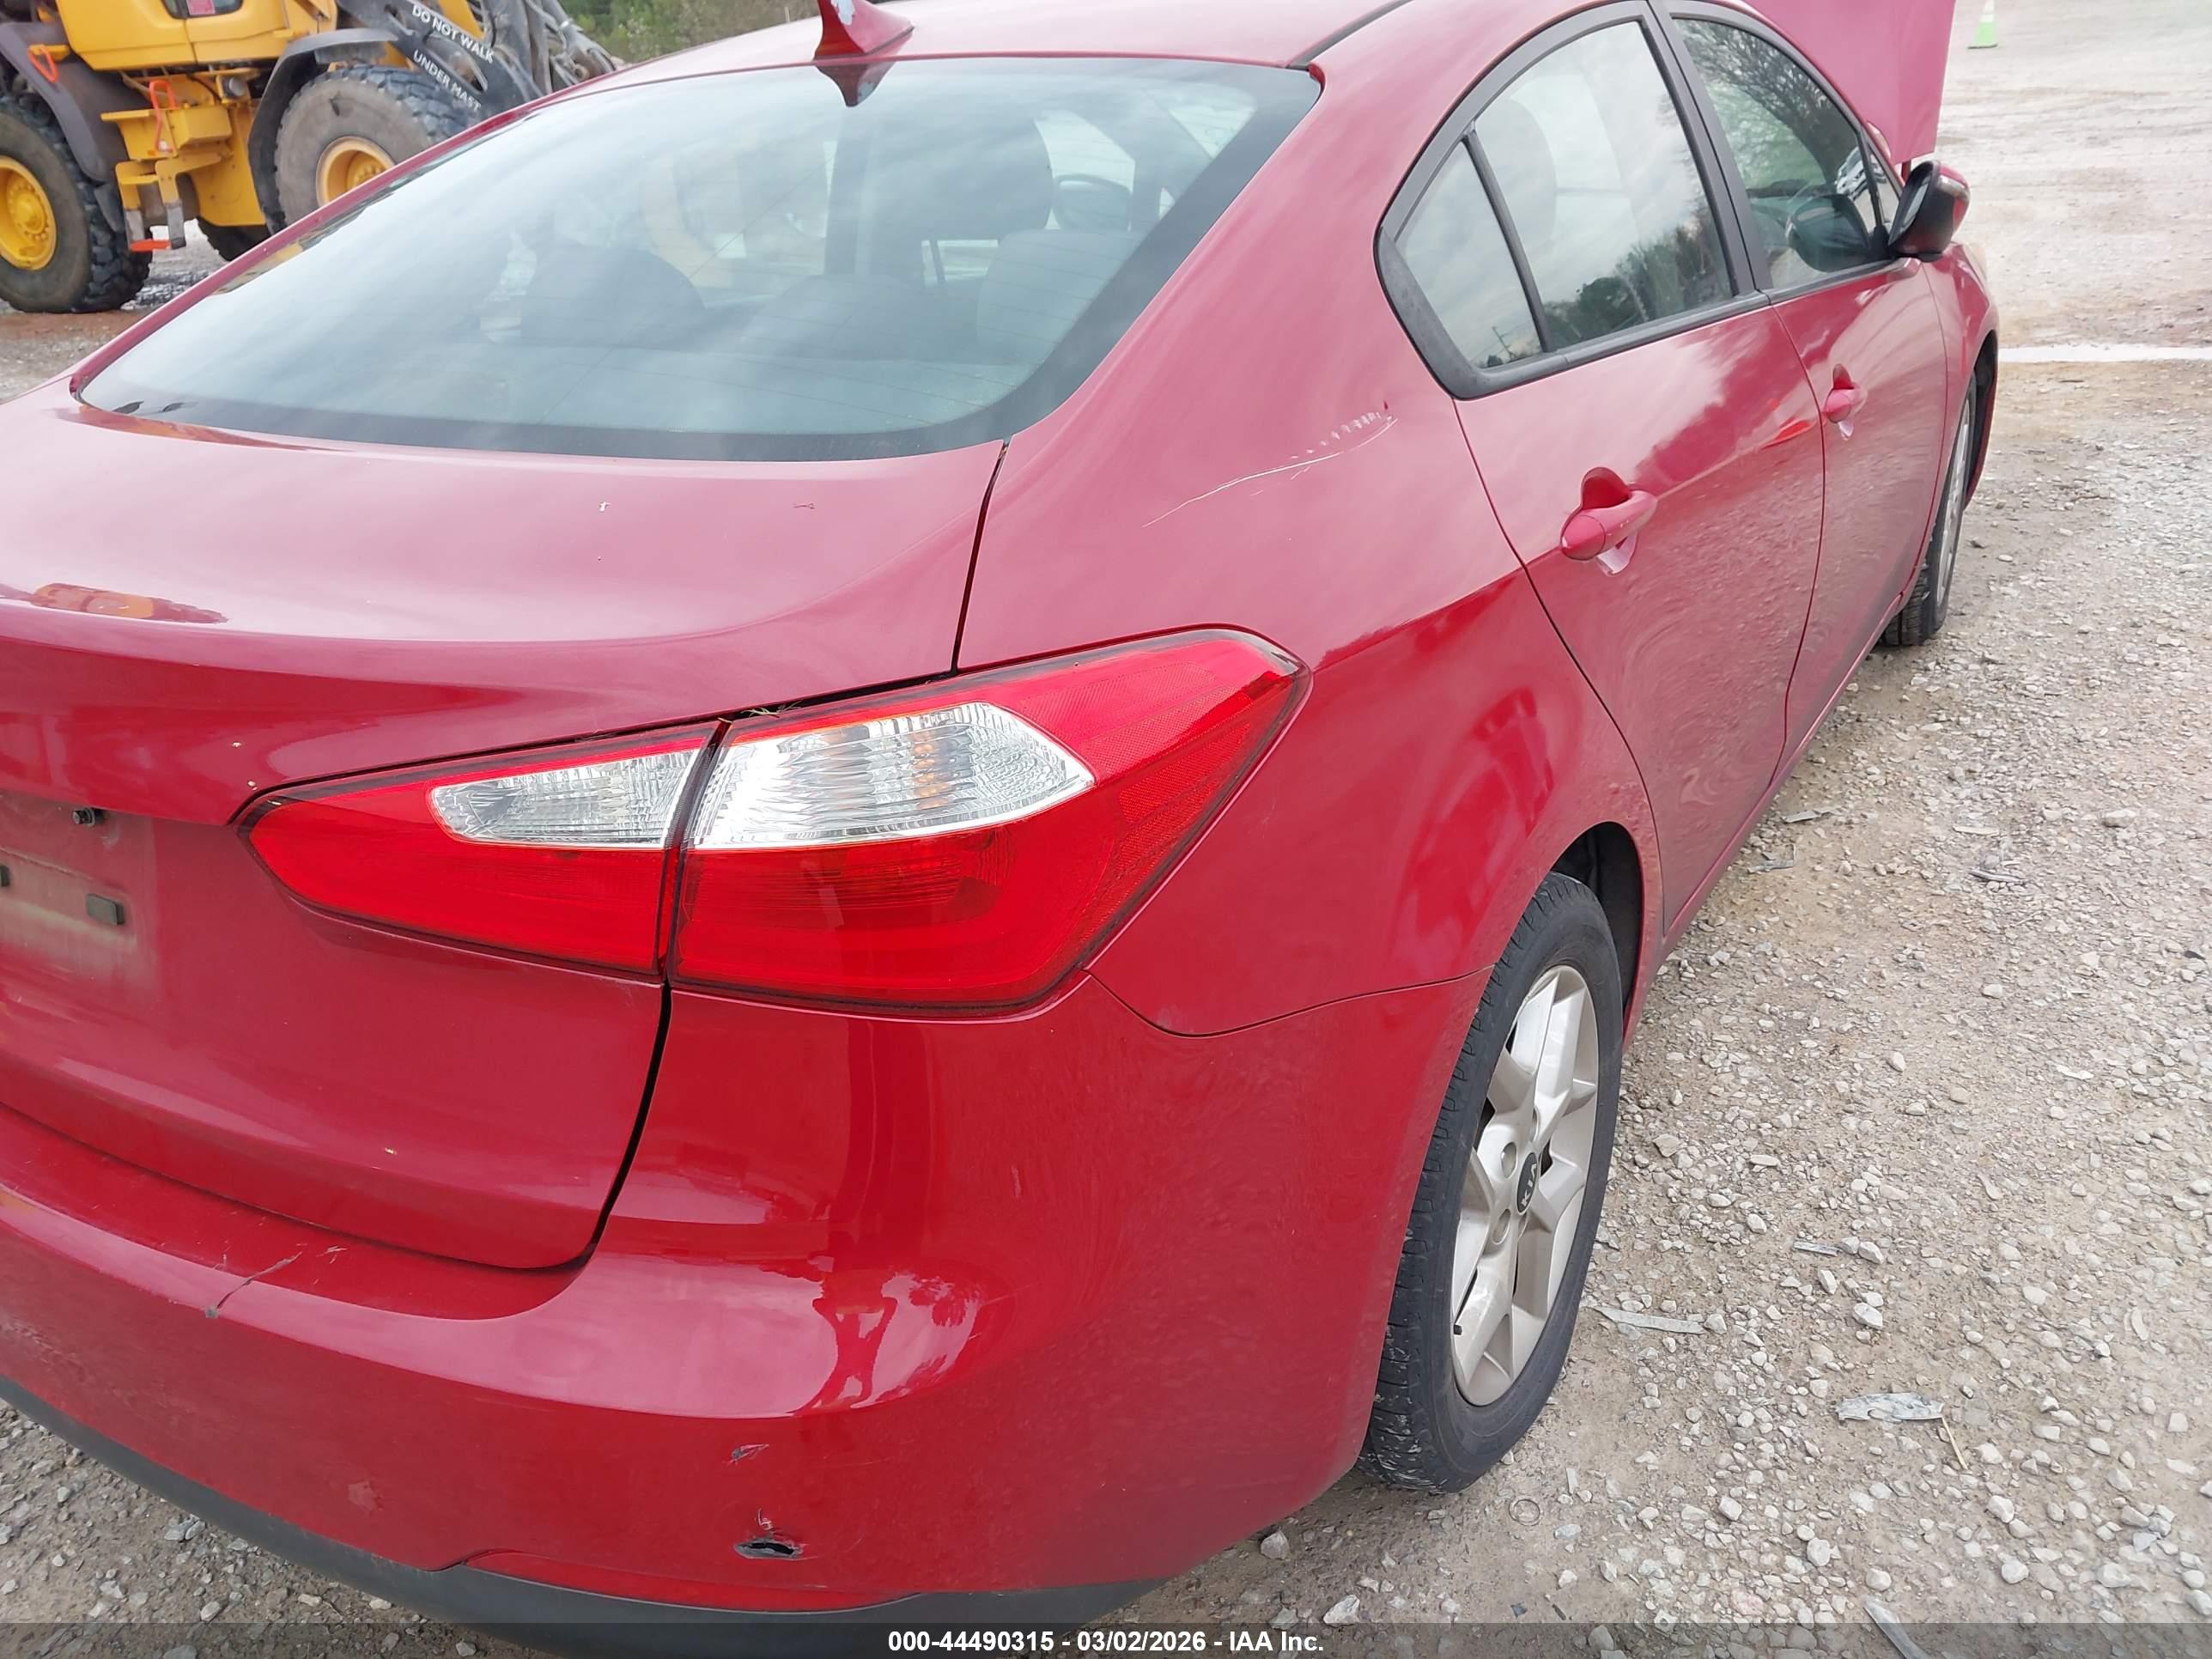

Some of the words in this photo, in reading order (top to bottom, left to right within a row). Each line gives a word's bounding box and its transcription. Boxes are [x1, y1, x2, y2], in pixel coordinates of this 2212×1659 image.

[412, 4, 431, 23] DO
[432, 18, 458, 40] NOT
[460, 33, 495, 64] WALK
[413, 49, 451, 89] UNDER
[451, 82, 482, 112] MAST
[1521, 1163, 1537, 1207] KIA
